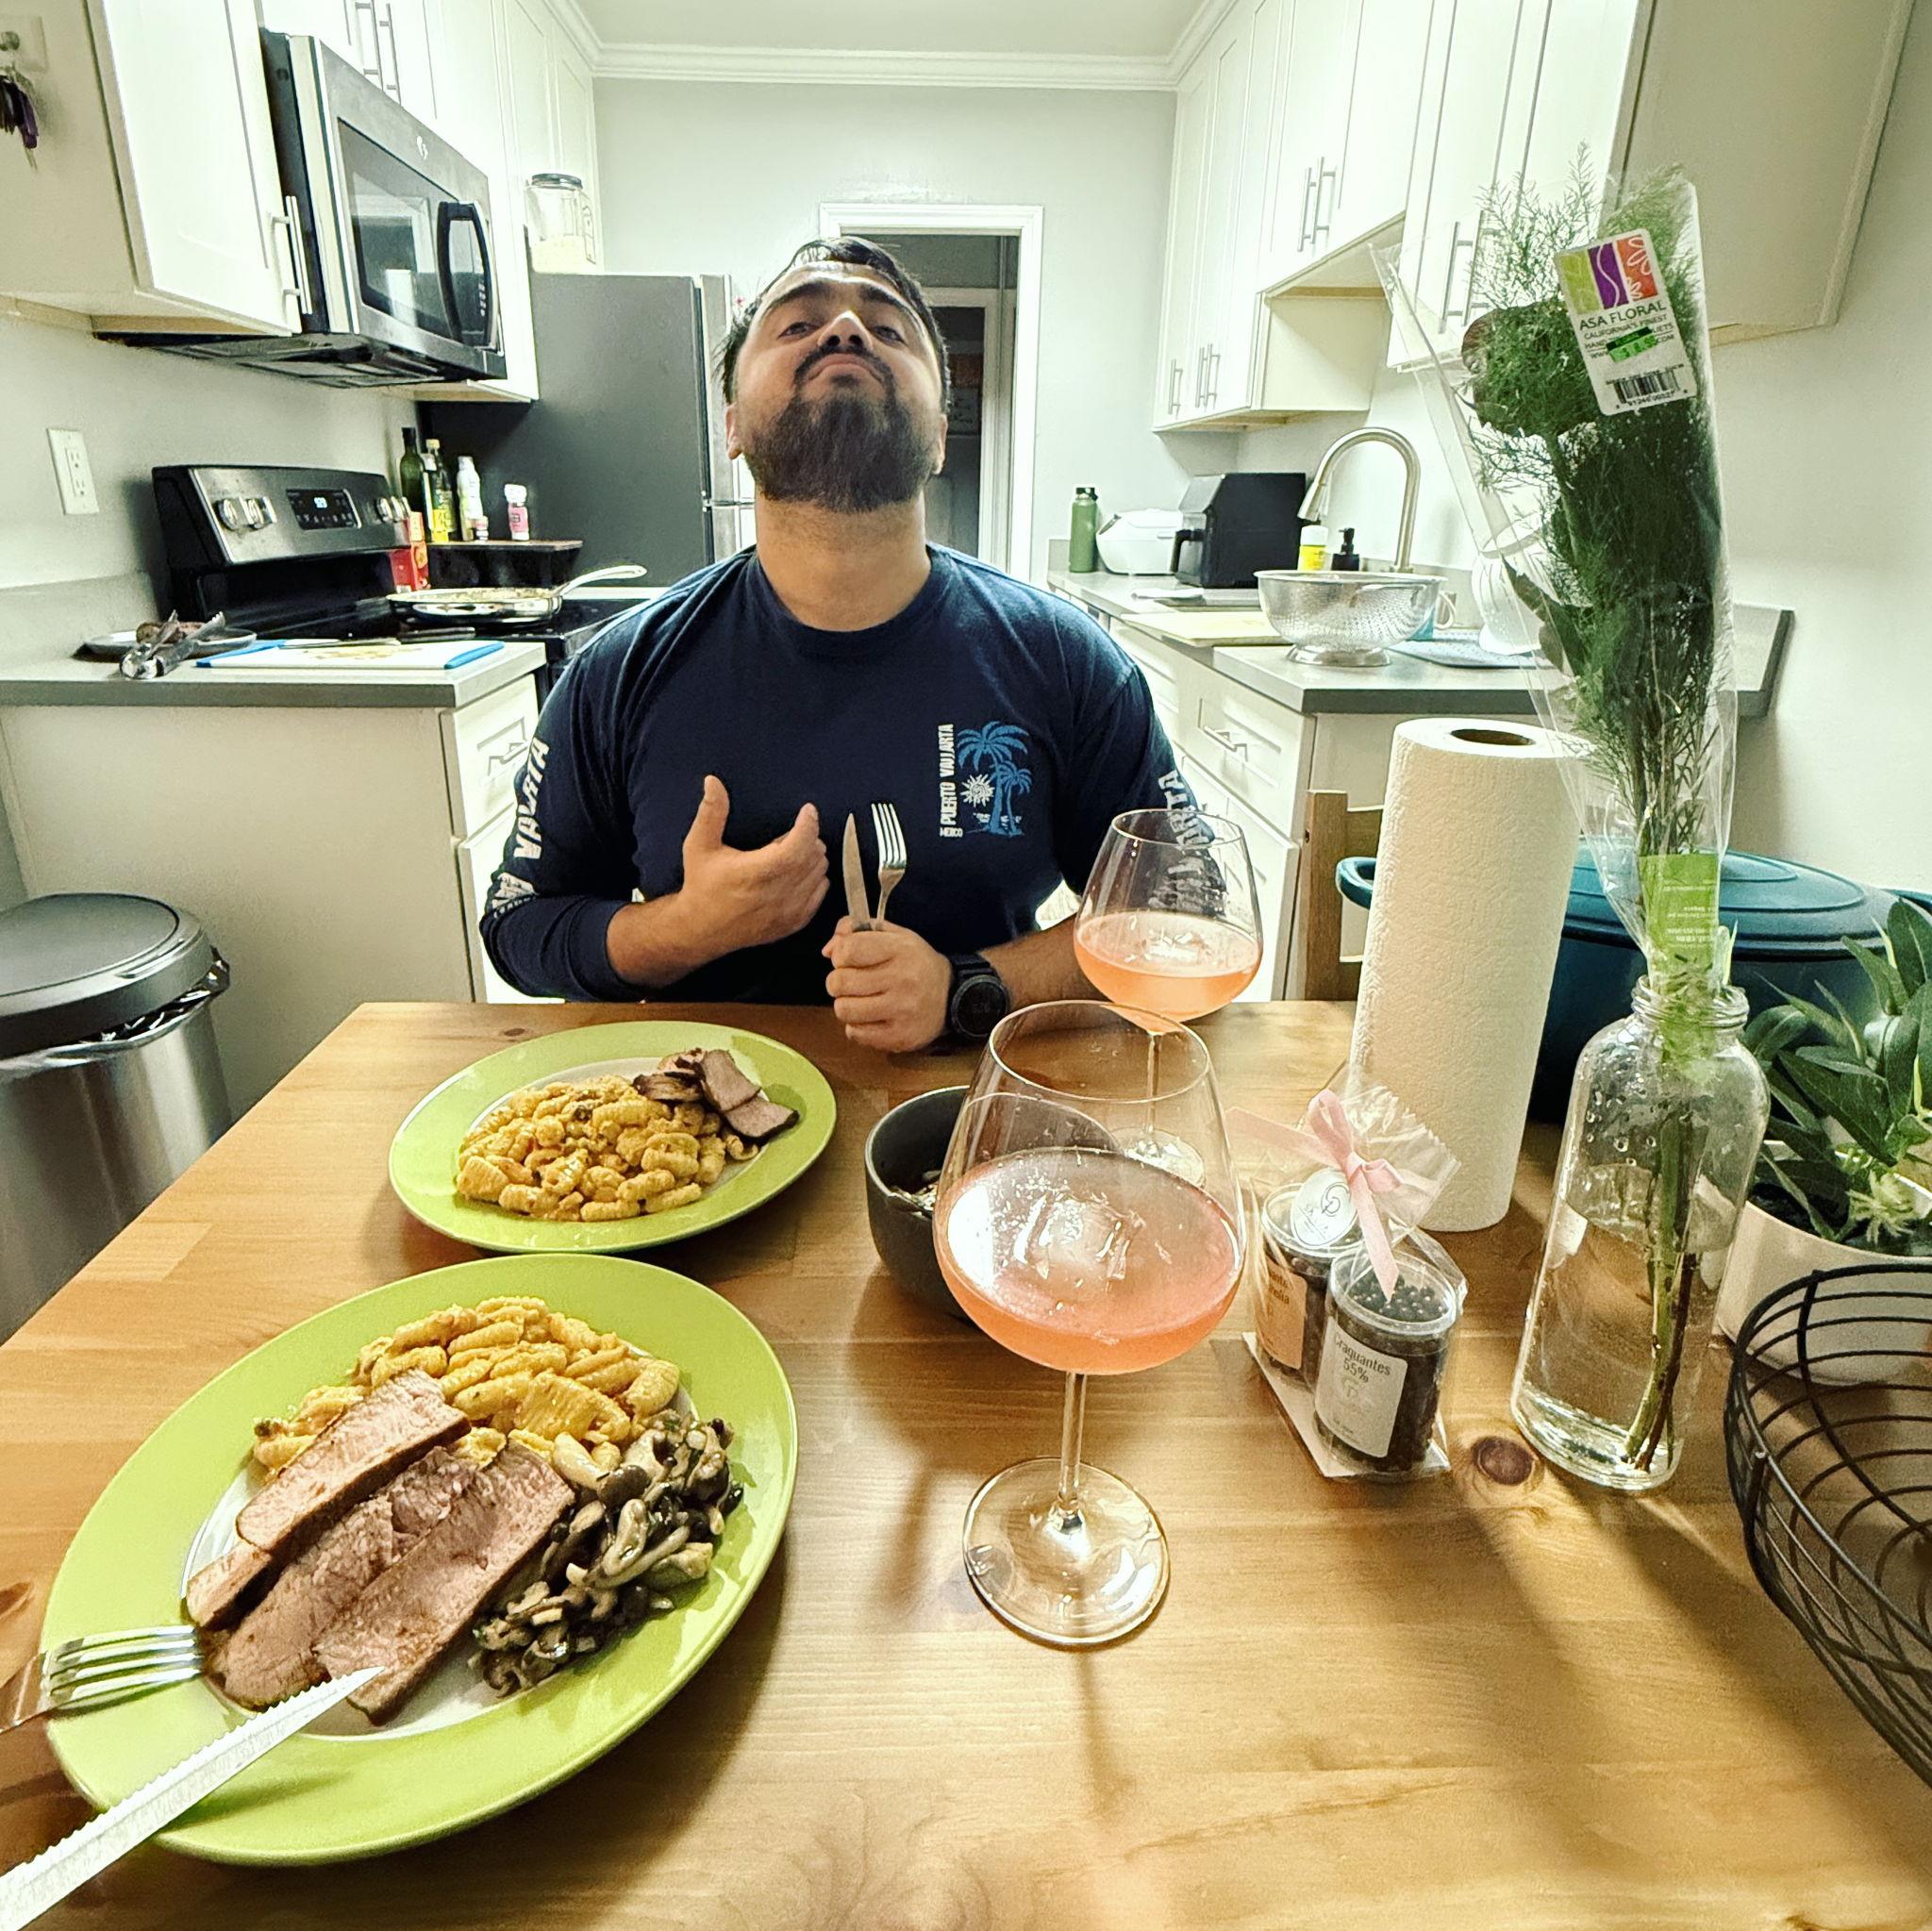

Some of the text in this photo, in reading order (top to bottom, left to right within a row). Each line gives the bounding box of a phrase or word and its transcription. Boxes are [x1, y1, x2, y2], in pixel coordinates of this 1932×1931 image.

[1579, 301, 1667, 330] ASA FLORAL
[938, 724, 958, 825] PUERTO VALLARTA
[1343, 1357, 1369, 1383] 55%
